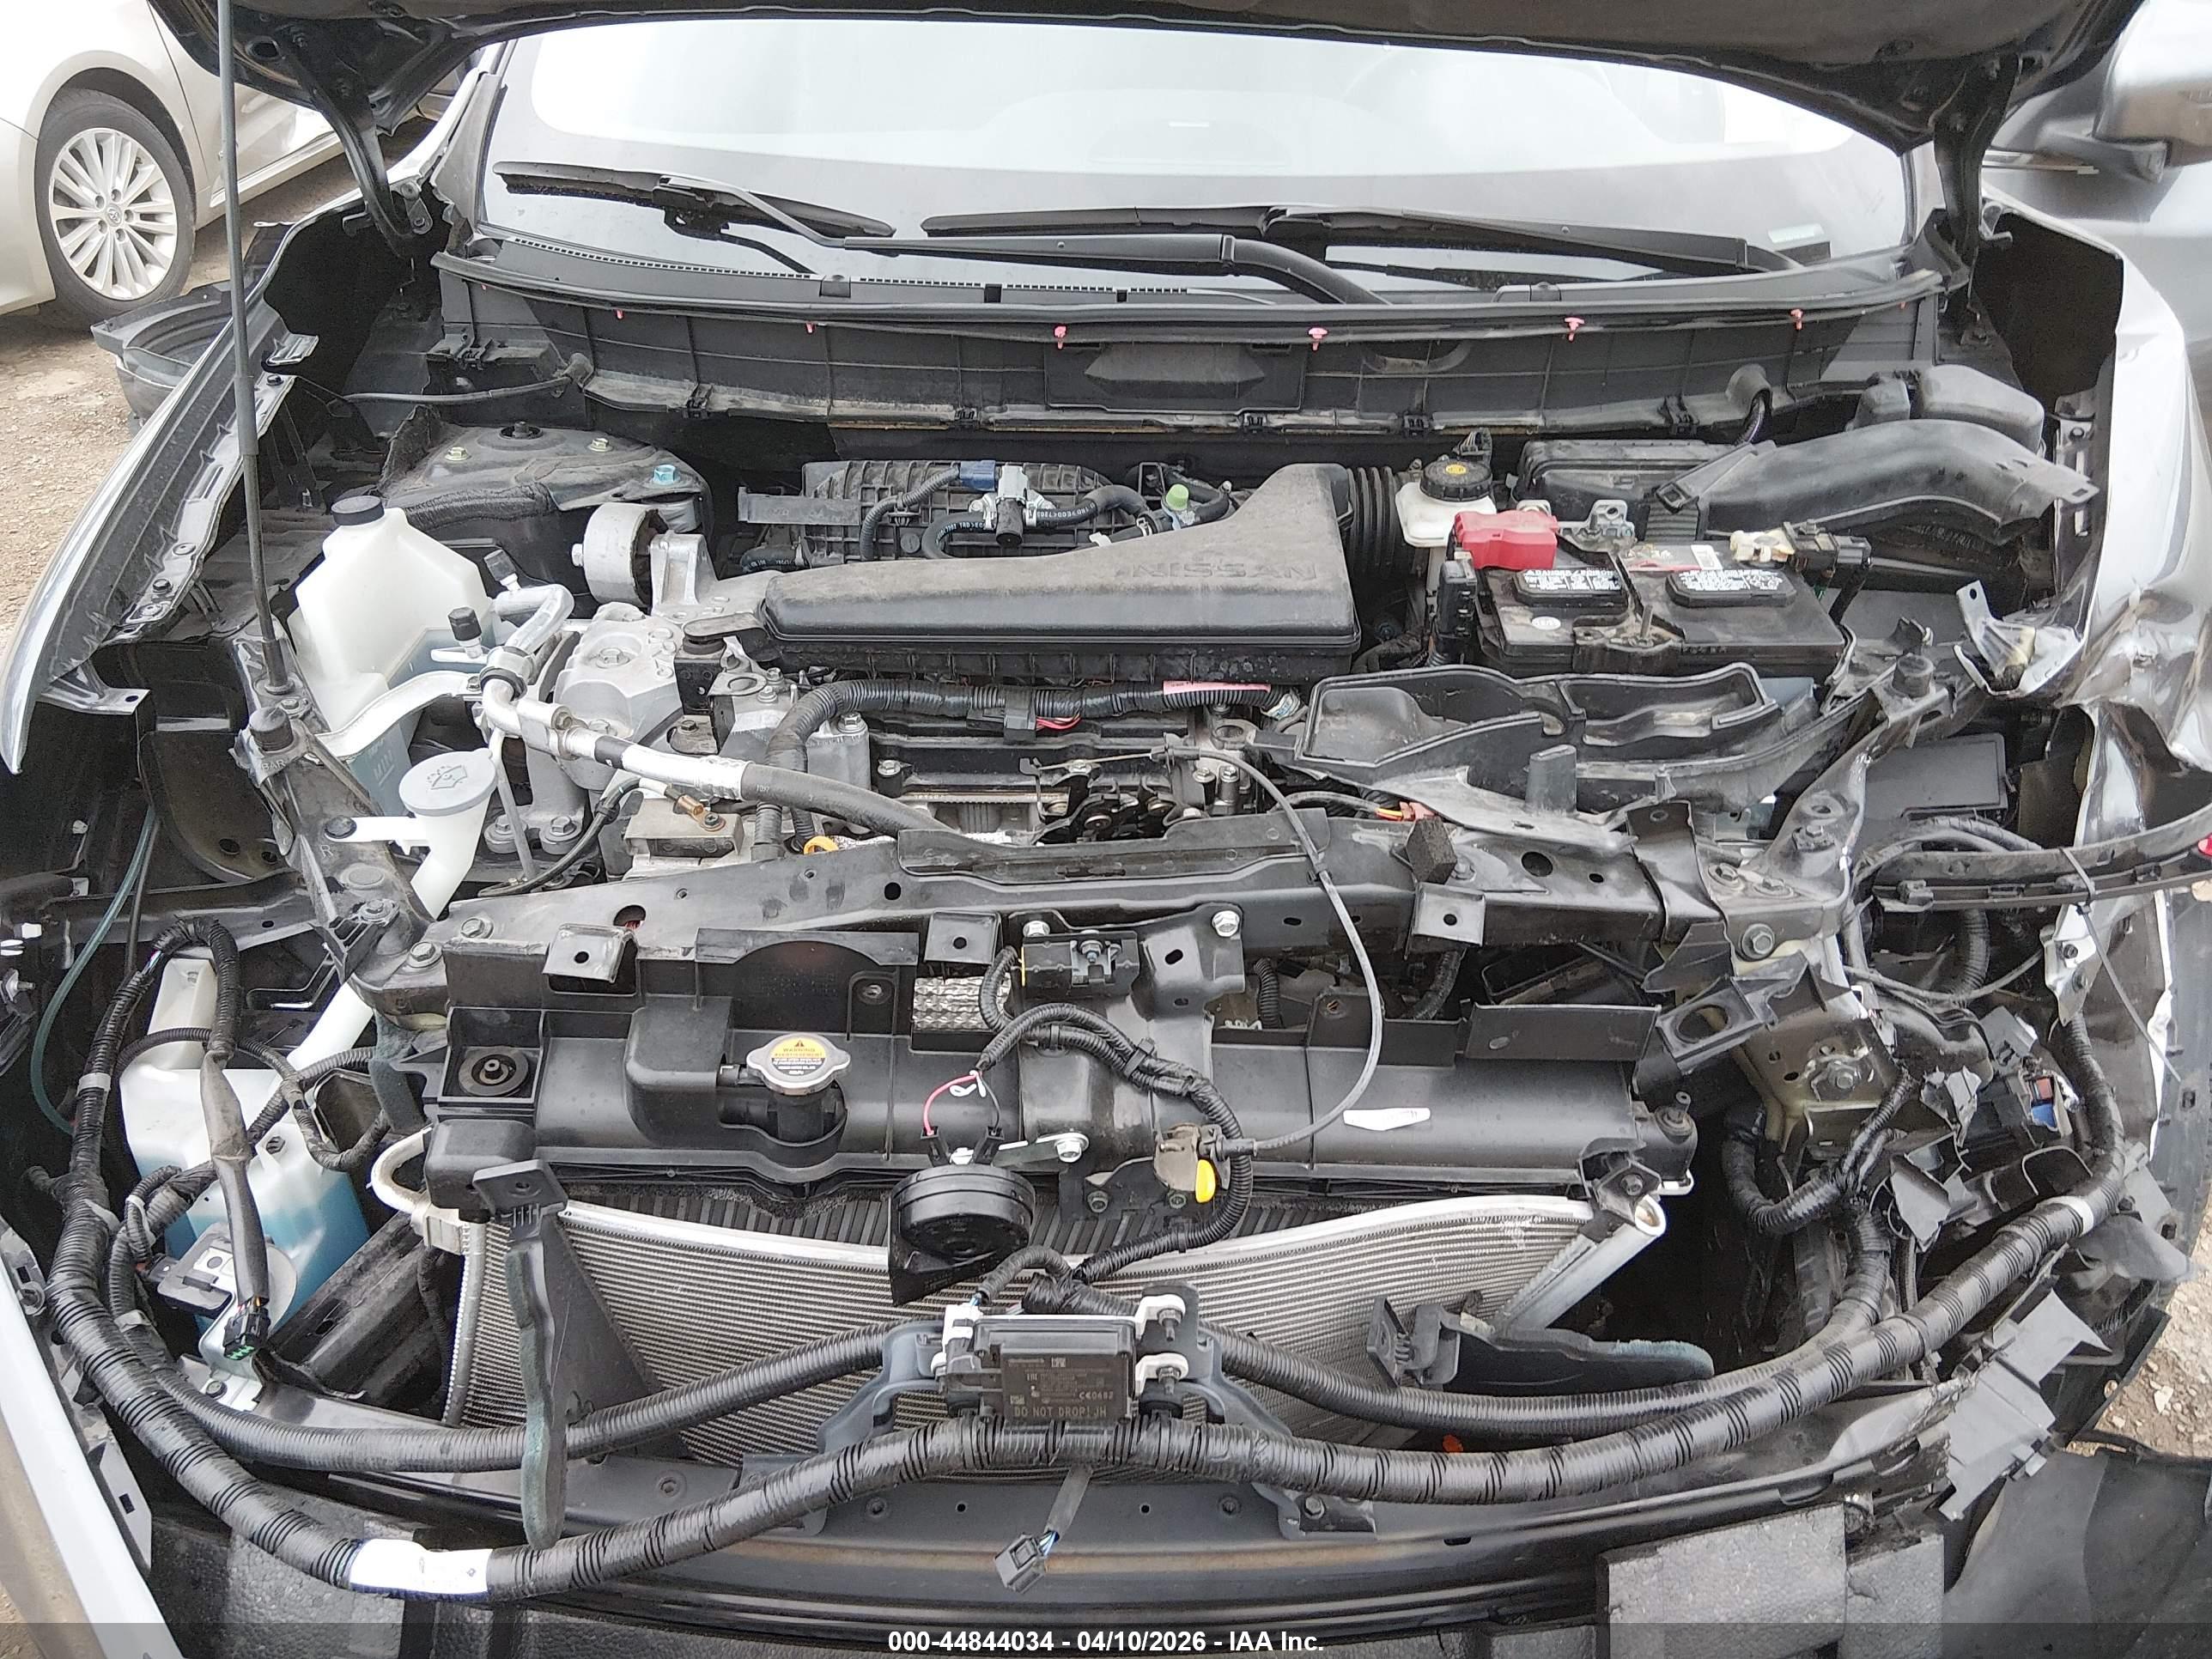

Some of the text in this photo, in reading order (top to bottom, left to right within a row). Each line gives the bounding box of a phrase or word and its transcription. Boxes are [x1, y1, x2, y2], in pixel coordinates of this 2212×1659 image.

[1133, 562, 1318, 580] NISSAN
[261, 759, 286, 770] BAR
[1014, 1407, 1029, 1417] DO
[1033, 1407, 1054, 1417] NOT
